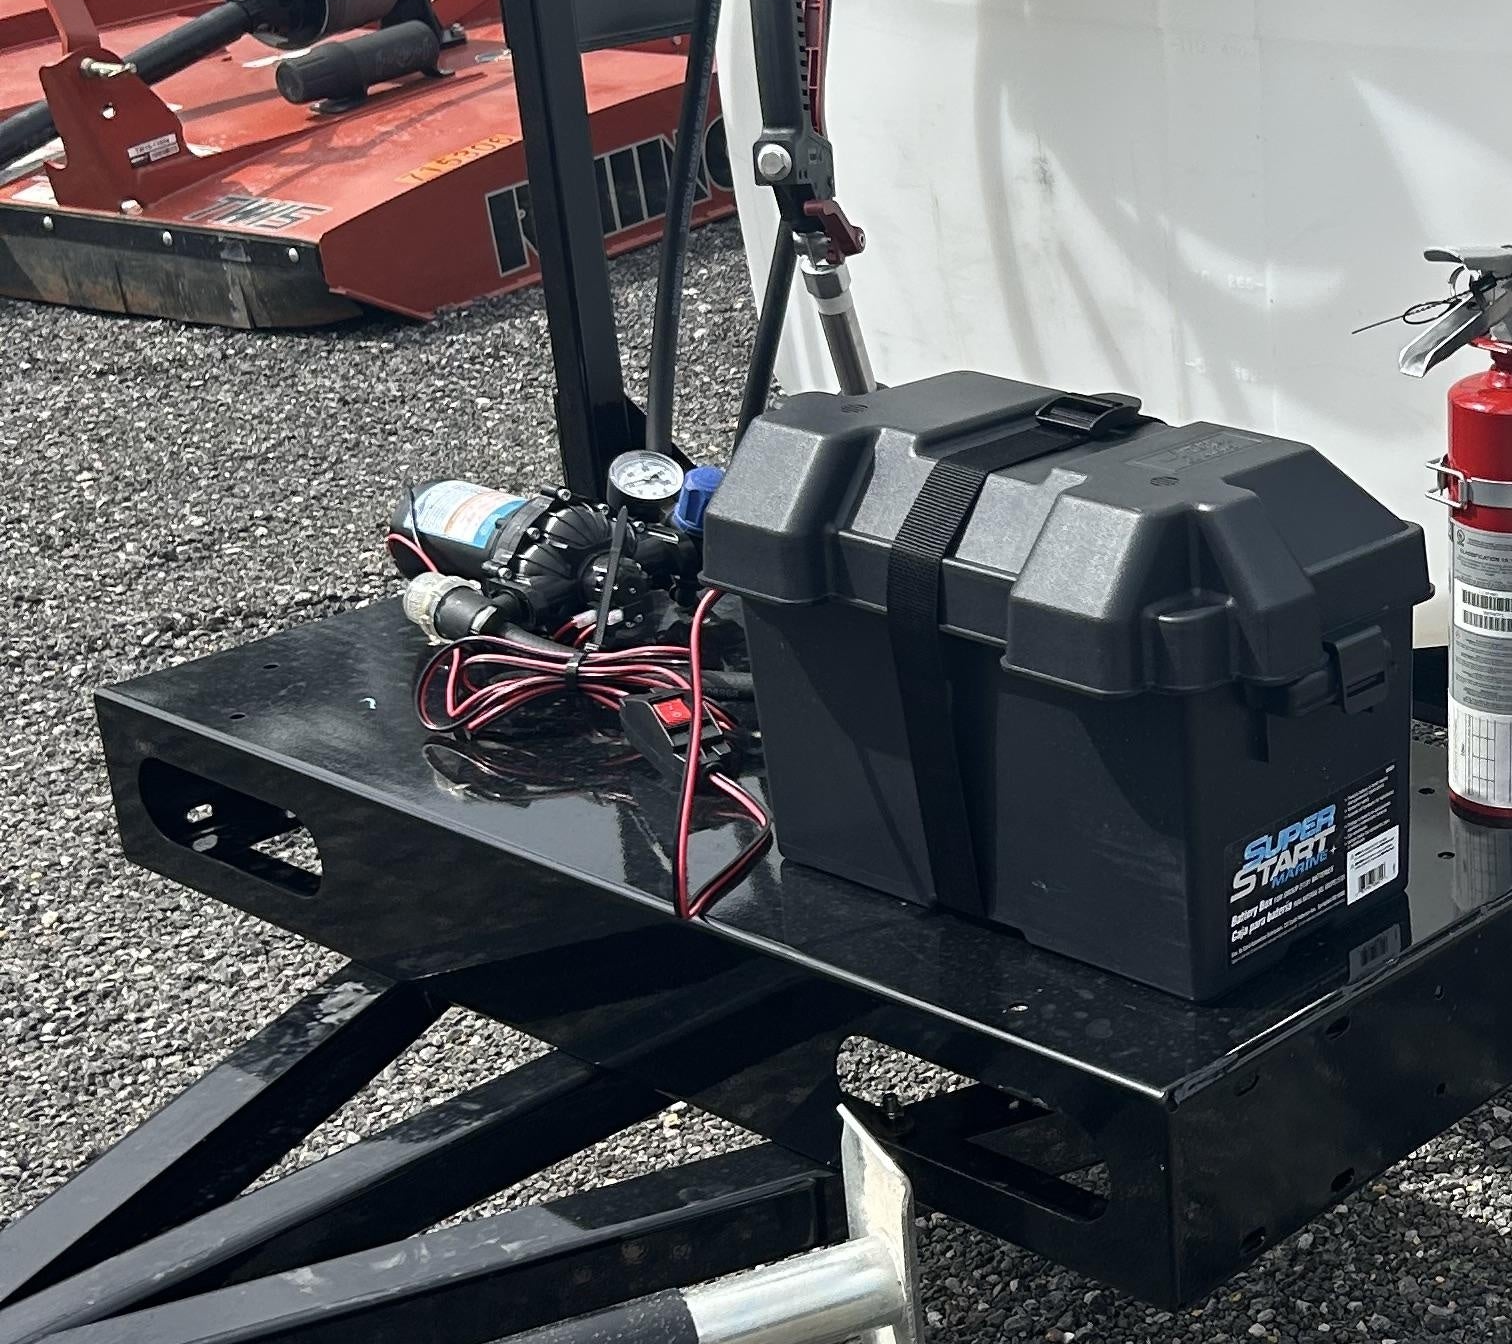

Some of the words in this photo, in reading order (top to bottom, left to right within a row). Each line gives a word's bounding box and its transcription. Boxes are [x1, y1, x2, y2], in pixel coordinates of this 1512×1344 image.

[1243, 803, 1337, 873] SUPER
[1229, 824, 1337, 904] START
[1271, 849, 1329, 889] MARINE
[1231, 905, 1259, 928] Battery
[1259, 897, 1274, 913] Box
[1231, 925, 1249, 943] Caja
[1249, 916, 1267, 935] para
